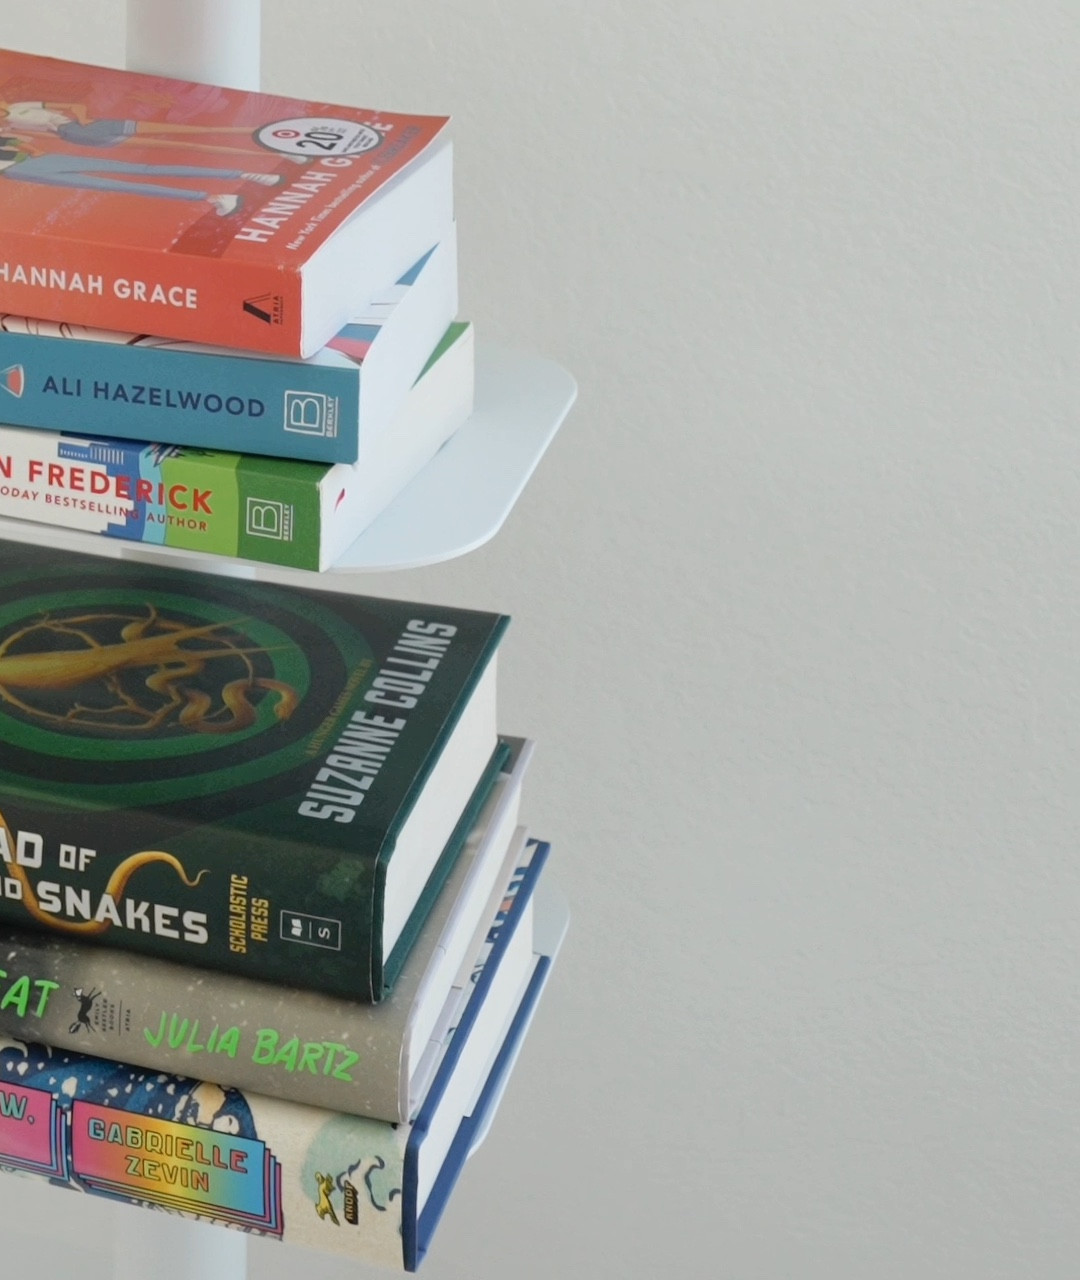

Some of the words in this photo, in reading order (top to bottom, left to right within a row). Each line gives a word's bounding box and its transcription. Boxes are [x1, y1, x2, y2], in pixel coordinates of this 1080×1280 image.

[234, 170, 338, 243] HANNAH
[113, 277, 198, 310] GRACE
[42, 374, 82, 397] ALI
[93, 381, 266, 419] HAZELWOOD
[326, 396, 334, 437] BERKLEY
[28, 459, 214, 516] FREDERICK
[45, 493, 140, 521] BESTSELLING
[146, 513, 208, 533] AUTHOR
[297, 708, 408, 825] SUZANNE
[363, 617, 458, 710] COLLINS
[59, 843, 97, 872] OF
[36, 880, 209, 945] SNAKES
[229, 873, 249, 954] SCHOLASTIC
[250, 896, 269, 942] PRESS
[144, 1011, 240, 1059] JULIA
[252, 1028, 360, 1083] BARTZ
[88, 1118, 249, 1174] GABRIELLE
[124, 1154, 211, 1193] ZEVIN
